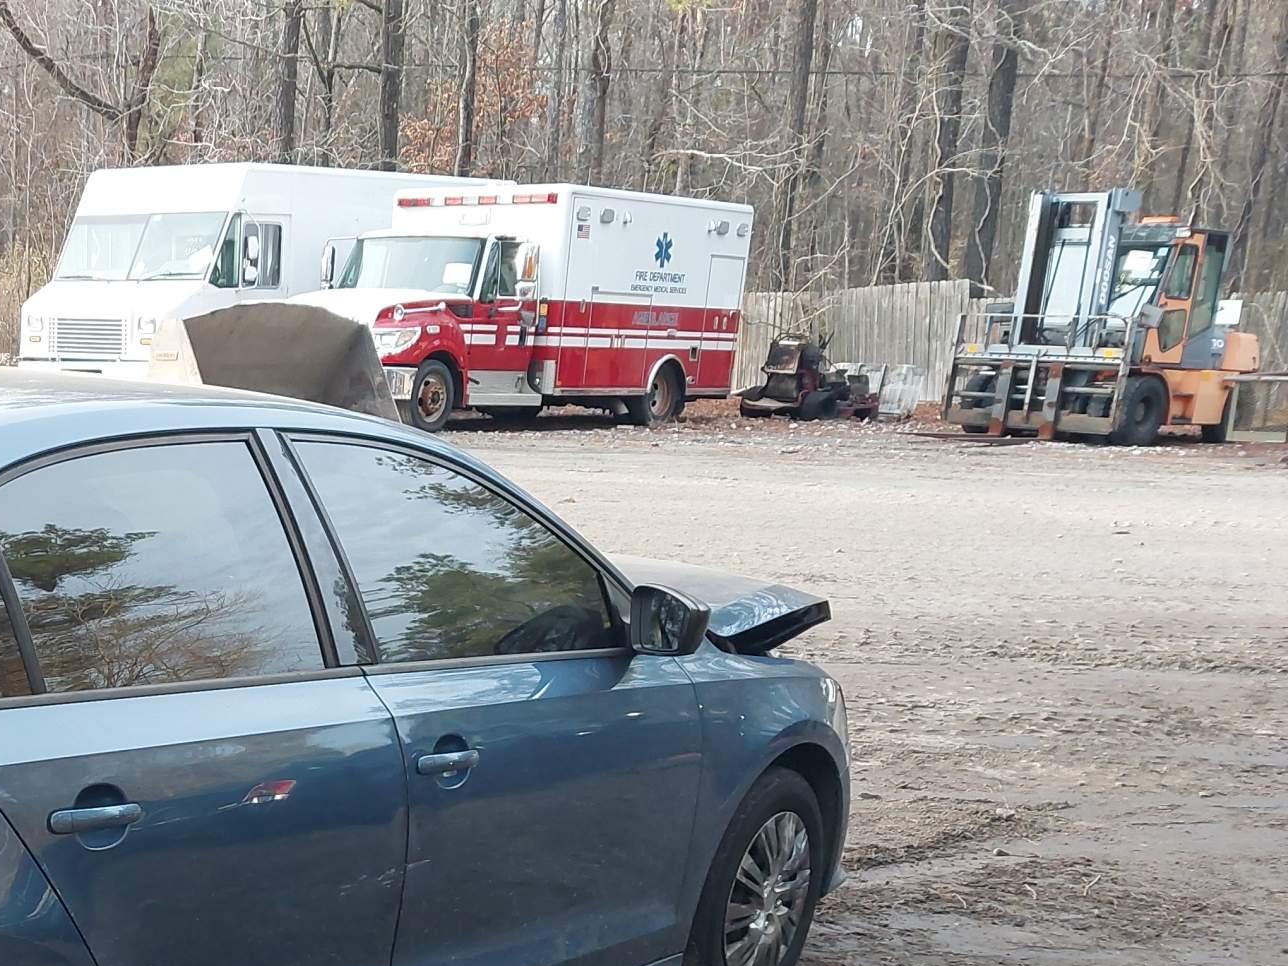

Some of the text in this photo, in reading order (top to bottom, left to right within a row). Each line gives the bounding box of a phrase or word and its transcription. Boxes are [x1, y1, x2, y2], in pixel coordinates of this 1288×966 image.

[635, 270, 686, 284] FIRE DEPARTMENT
[1099, 235, 1117, 305] DOOSAN
